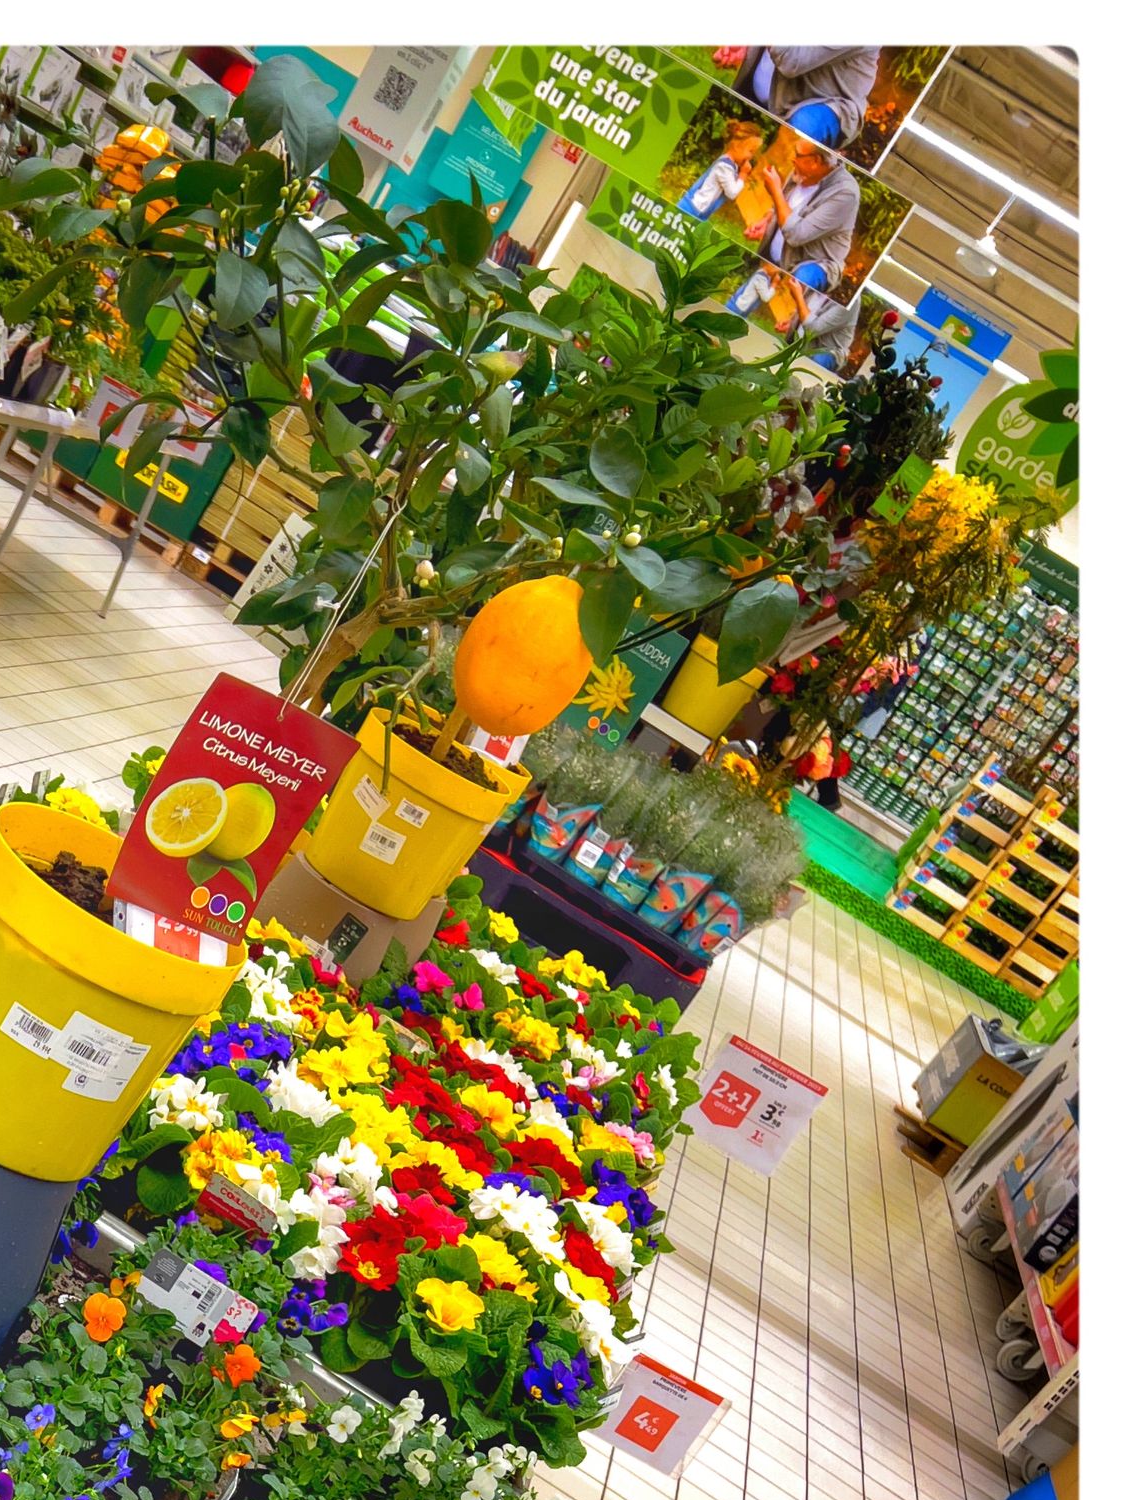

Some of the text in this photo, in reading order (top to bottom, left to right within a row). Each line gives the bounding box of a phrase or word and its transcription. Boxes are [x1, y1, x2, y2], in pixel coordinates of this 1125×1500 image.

[549, 51, 641, 115] une star
[534, 76, 566, 108] du
[558, 91, 631, 149] jardin
[347, 115, 394, 151] Auchan.fr
[619, 210, 643, 233] du
[631, 191, 696, 236] une sta
[974, 437, 1067, 496] garde
[635, 637, 671, 669] UDDHA
[199, 710, 326, 782] LIMONE MEYER
[203, 737, 302, 791] Citrus Meyerii
[182, 908, 237, 938] SUN TOUCH
[711, 1079, 753, 1112] 2+1
[713, 1100, 737, 1116] OFFERT
